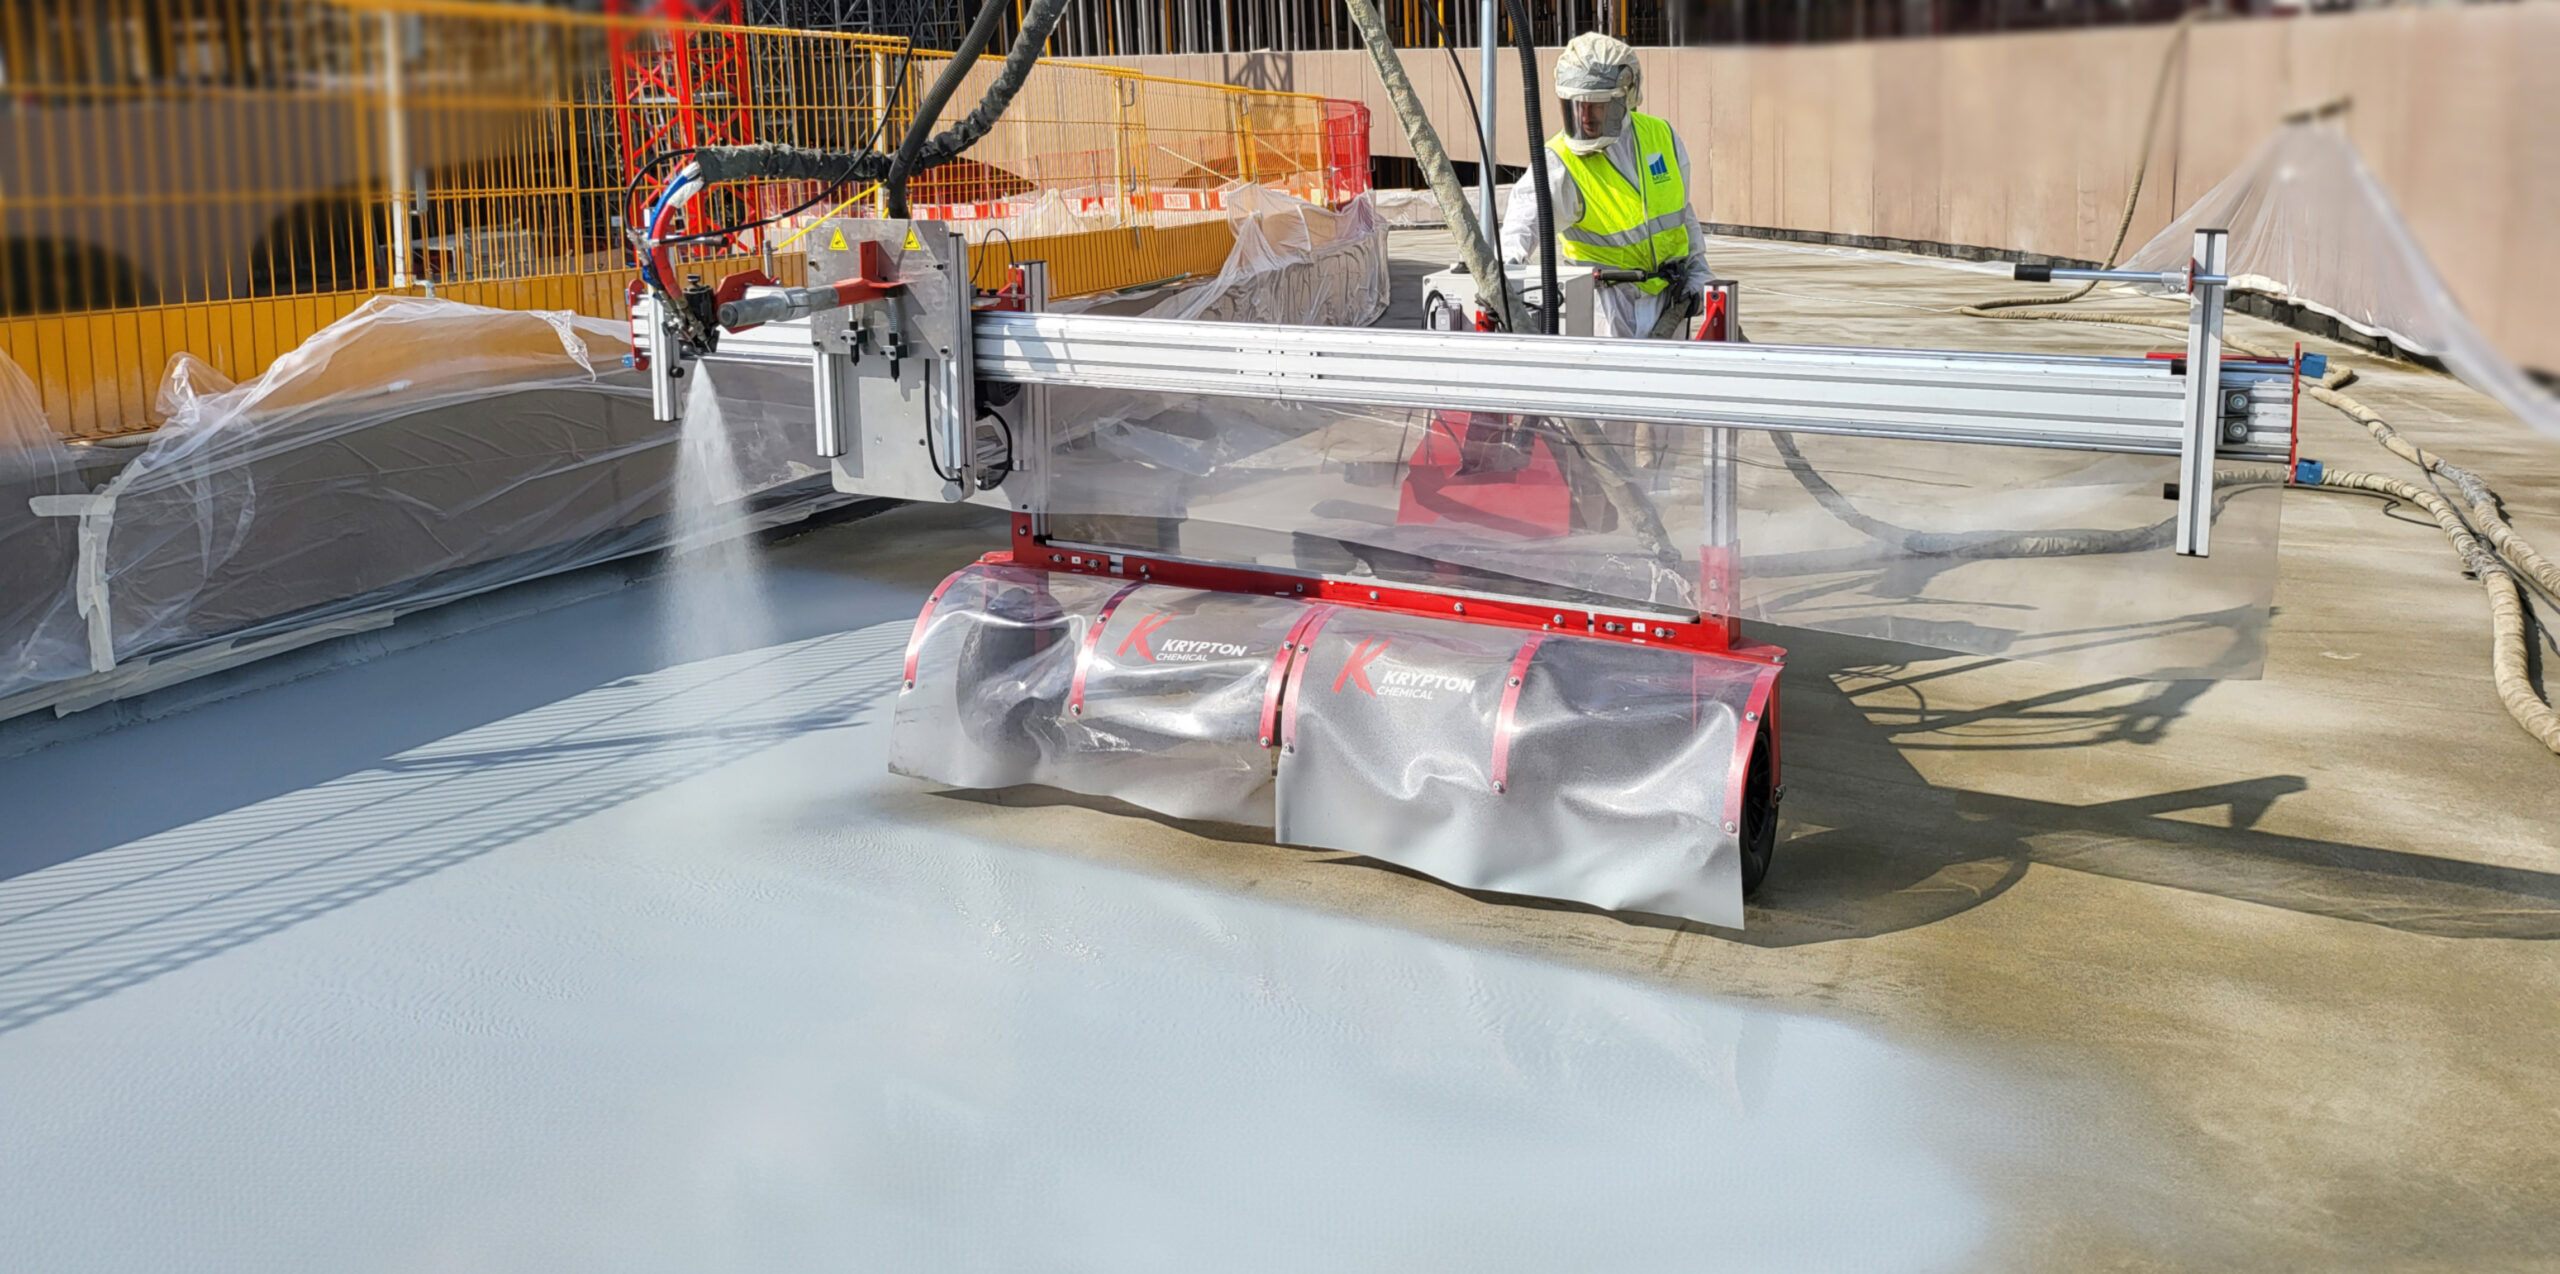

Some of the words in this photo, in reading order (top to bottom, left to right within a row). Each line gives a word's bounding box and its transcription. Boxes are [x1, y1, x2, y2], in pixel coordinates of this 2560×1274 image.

[1160, 639, 1247, 657] KRYPTON
[1156, 652, 1208, 662] CHEMICAL
[1382, 670, 1476, 694] KRYPTON
[1376, 685, 1433, 700] CHEMICAL
